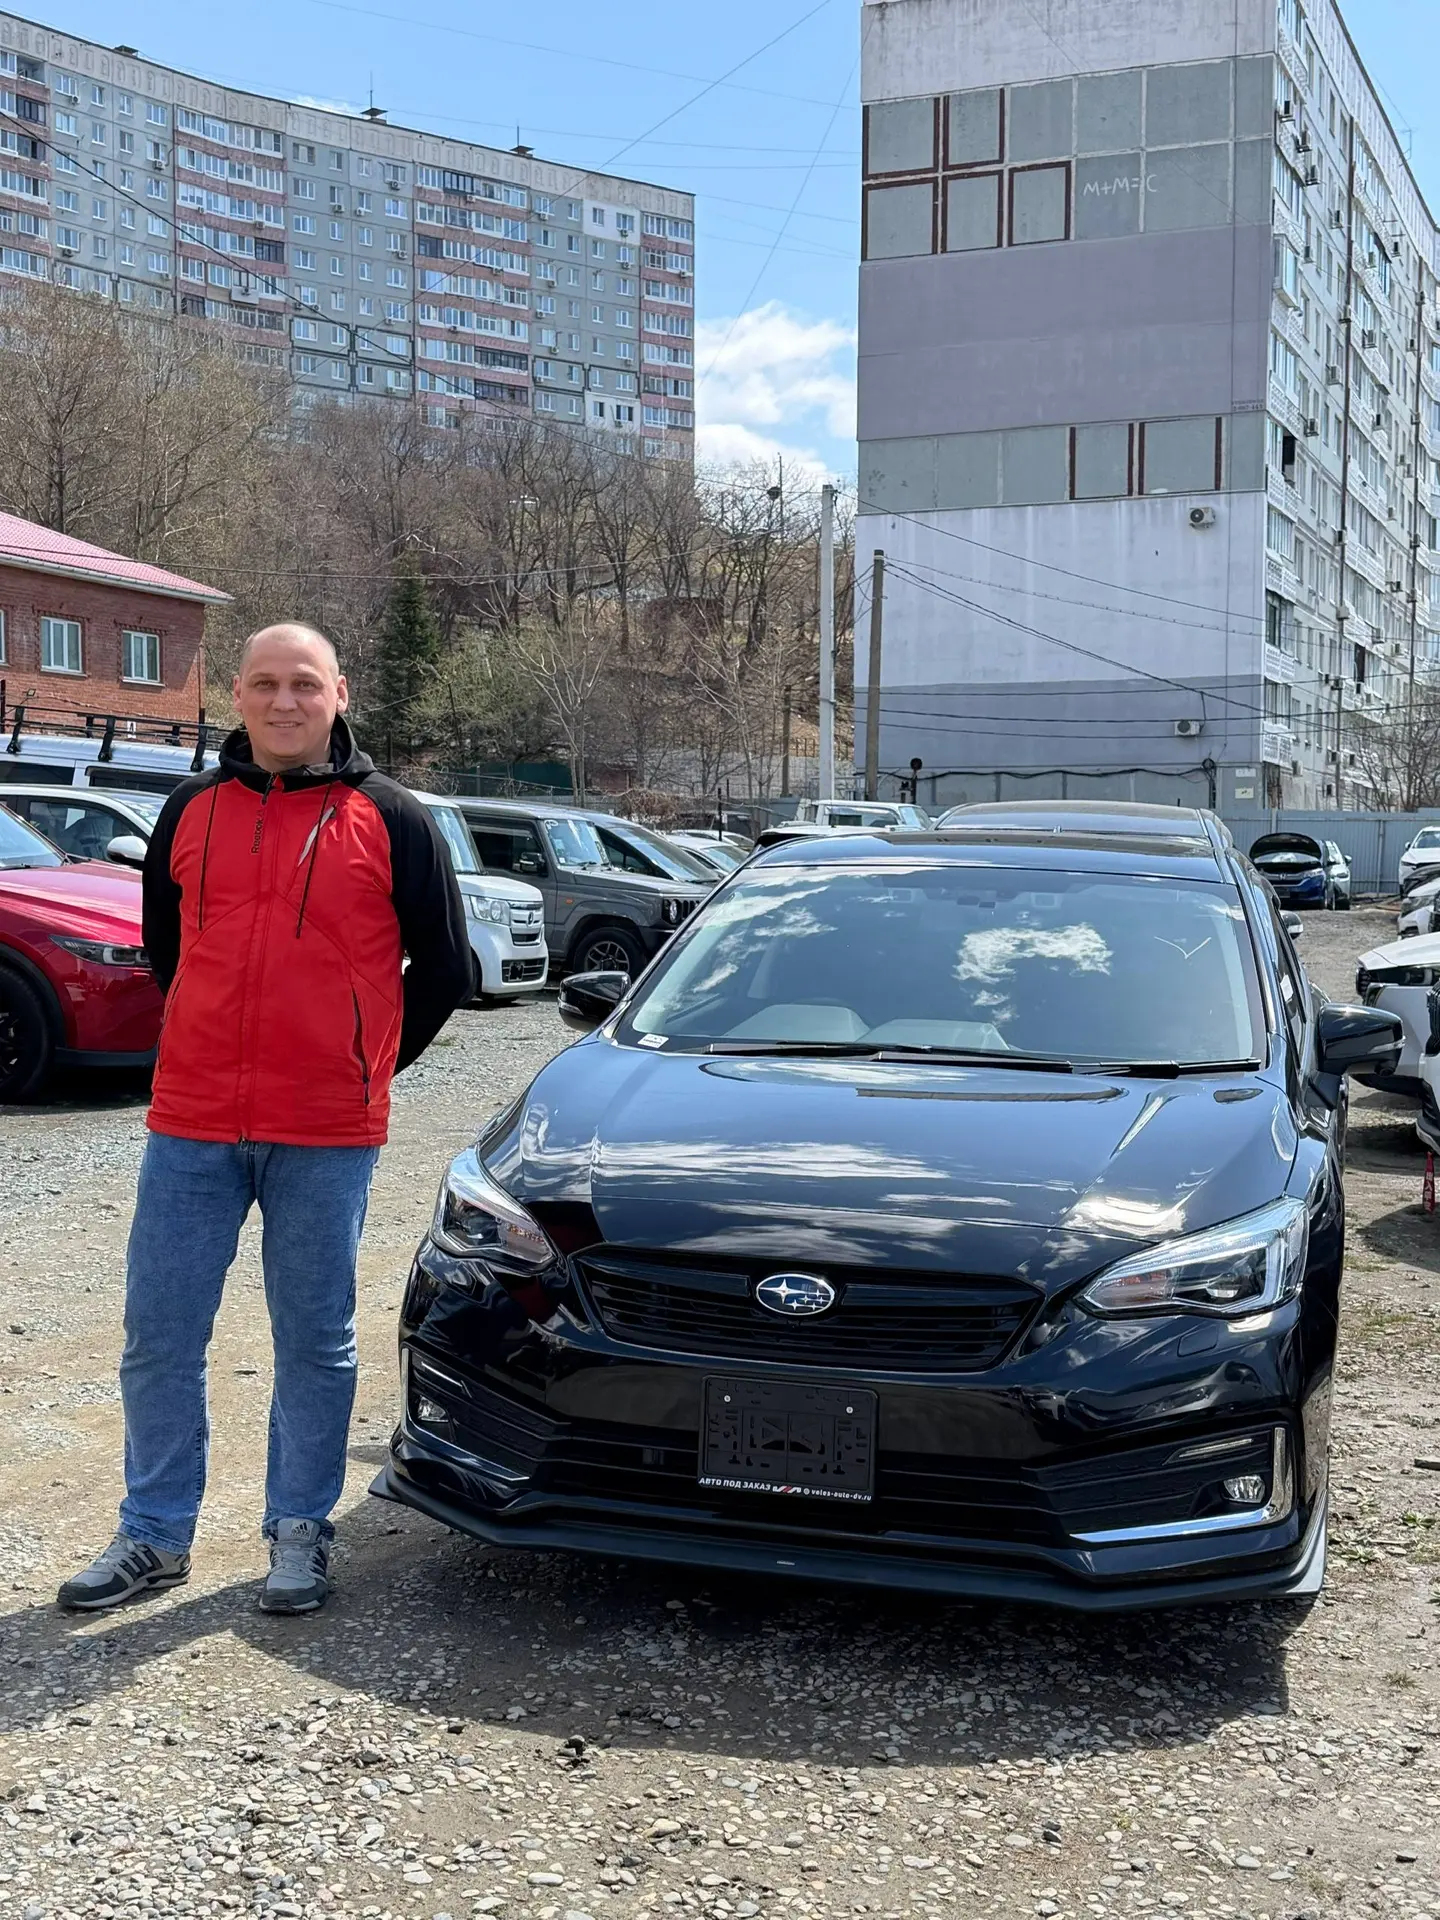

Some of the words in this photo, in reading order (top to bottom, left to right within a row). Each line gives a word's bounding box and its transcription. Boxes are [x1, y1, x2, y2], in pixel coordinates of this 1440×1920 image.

[251, 818, 264, 853] Reebok
[699, 1477, 721, 1486] АВТО
[723, 1480, 741, 1488] ПОД
[742, 1481, 771, 1491] ЗАКАЗ
[811, 1489, 872, 1501] veles-auto-dv.ru
